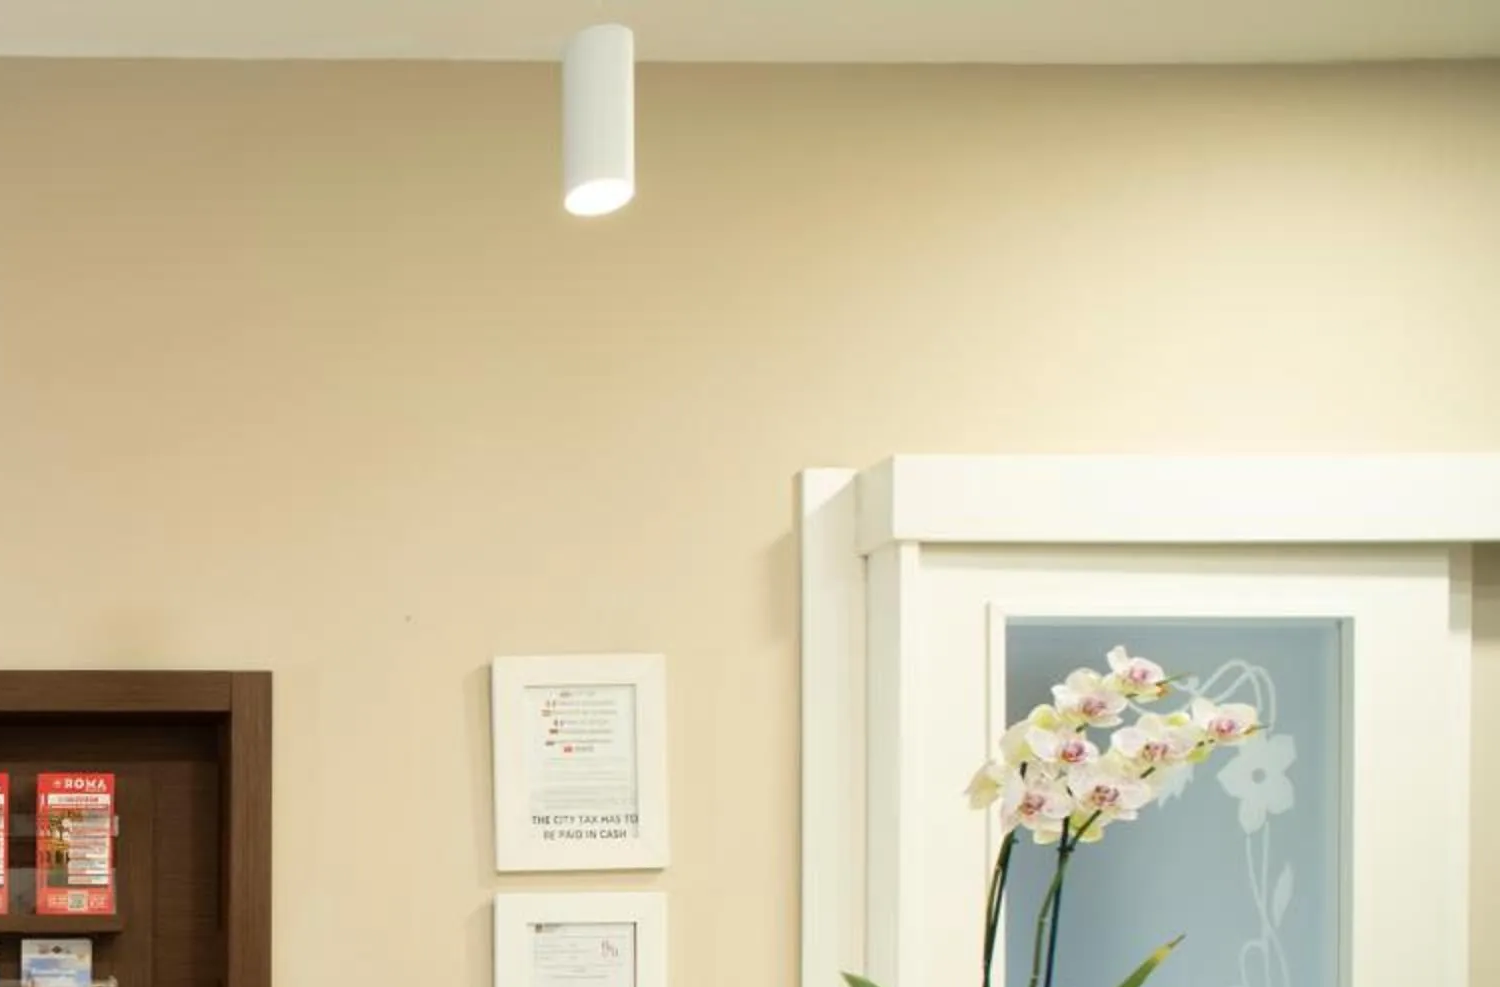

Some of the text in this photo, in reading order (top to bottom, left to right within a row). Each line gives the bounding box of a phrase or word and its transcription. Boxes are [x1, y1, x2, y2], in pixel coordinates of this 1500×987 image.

[63, 778, 107, 790] ROMA
[532, 815, 551, 825] THE
[553, 815, 575, 825] CITY
[579, 815, 598, 824] TAX
[601, 815, 621, 824] HAS
[543, 829, 627, 840] BE PAID IN CASH
